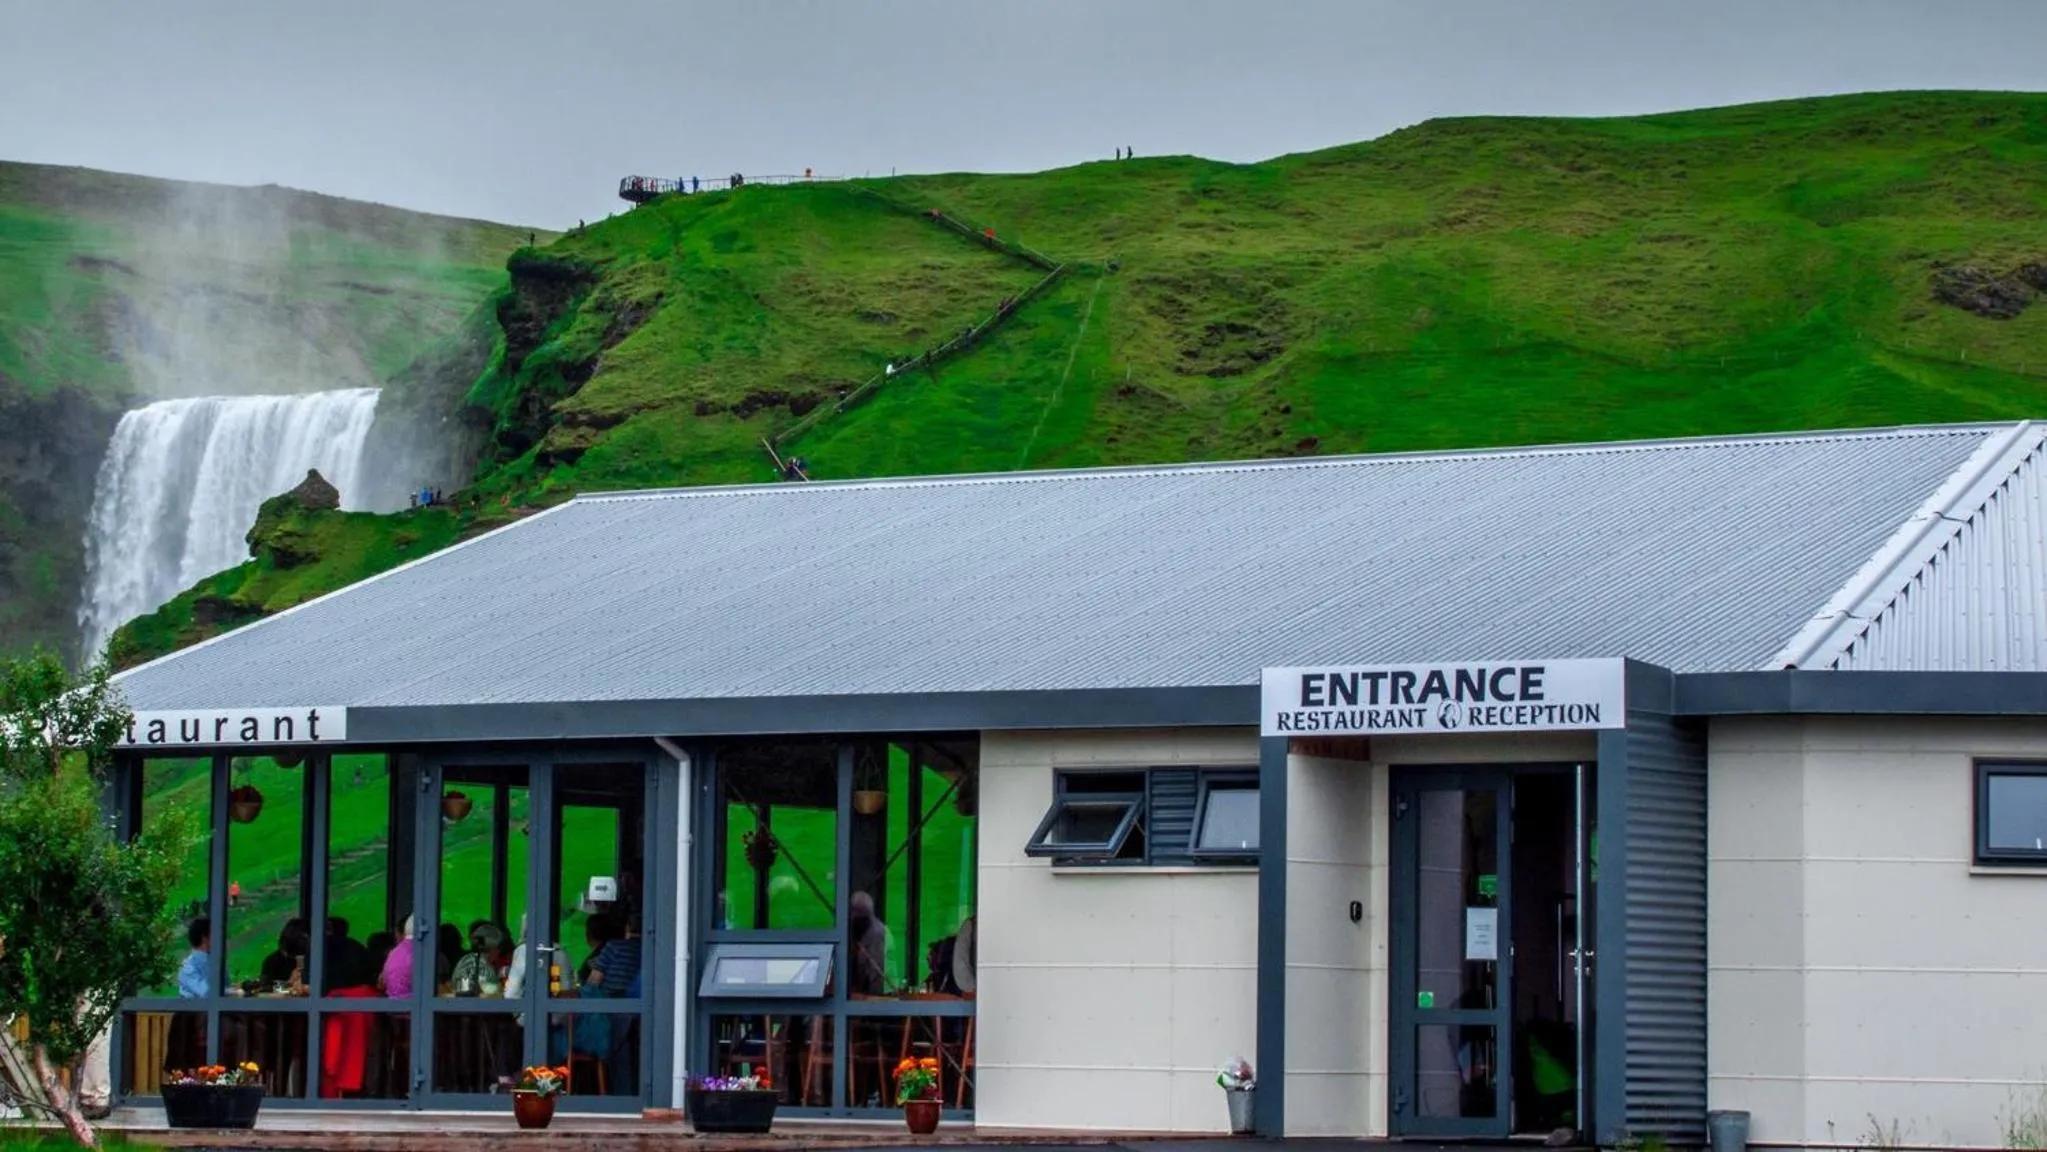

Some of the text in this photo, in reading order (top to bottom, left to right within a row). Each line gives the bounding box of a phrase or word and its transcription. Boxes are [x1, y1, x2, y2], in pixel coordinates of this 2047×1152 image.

[1301, 666, 1545, 707] ENTRANCE
[25, 707, 320, 745] taurant
[1277, 703, 1601, 731] RESTAURANT RECEPTION
